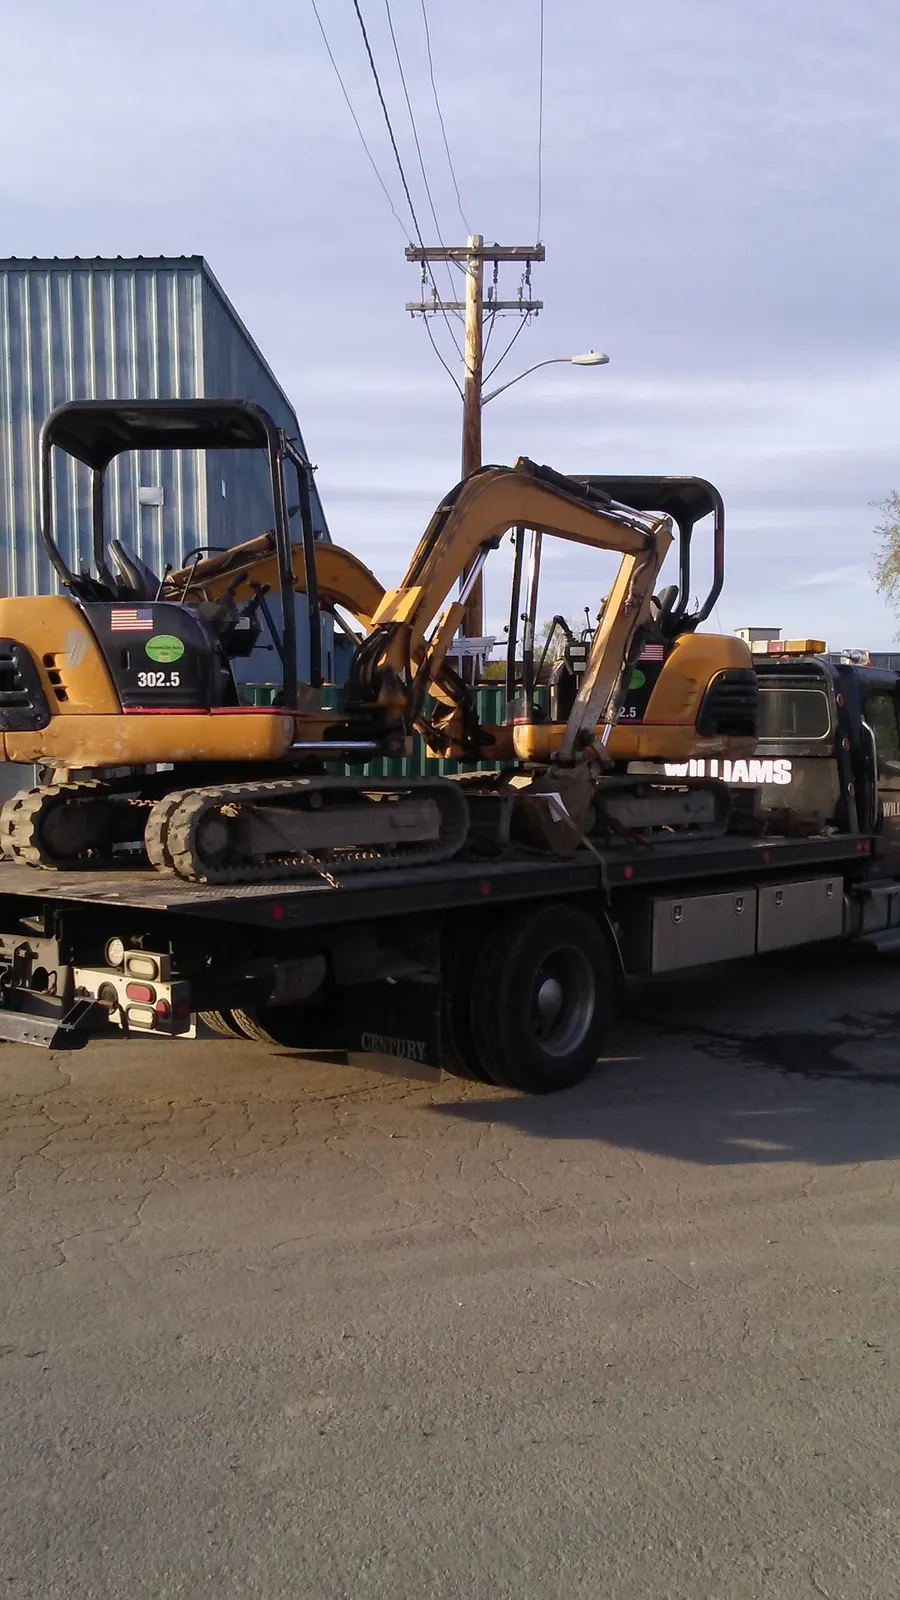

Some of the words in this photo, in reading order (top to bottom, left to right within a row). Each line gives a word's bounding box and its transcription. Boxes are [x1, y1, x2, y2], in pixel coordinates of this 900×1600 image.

[137, 671, 181, 687] 302.5
[618, 706, 637, 718] 2.5
[361, 1032, 427, 1061] CENTURY
